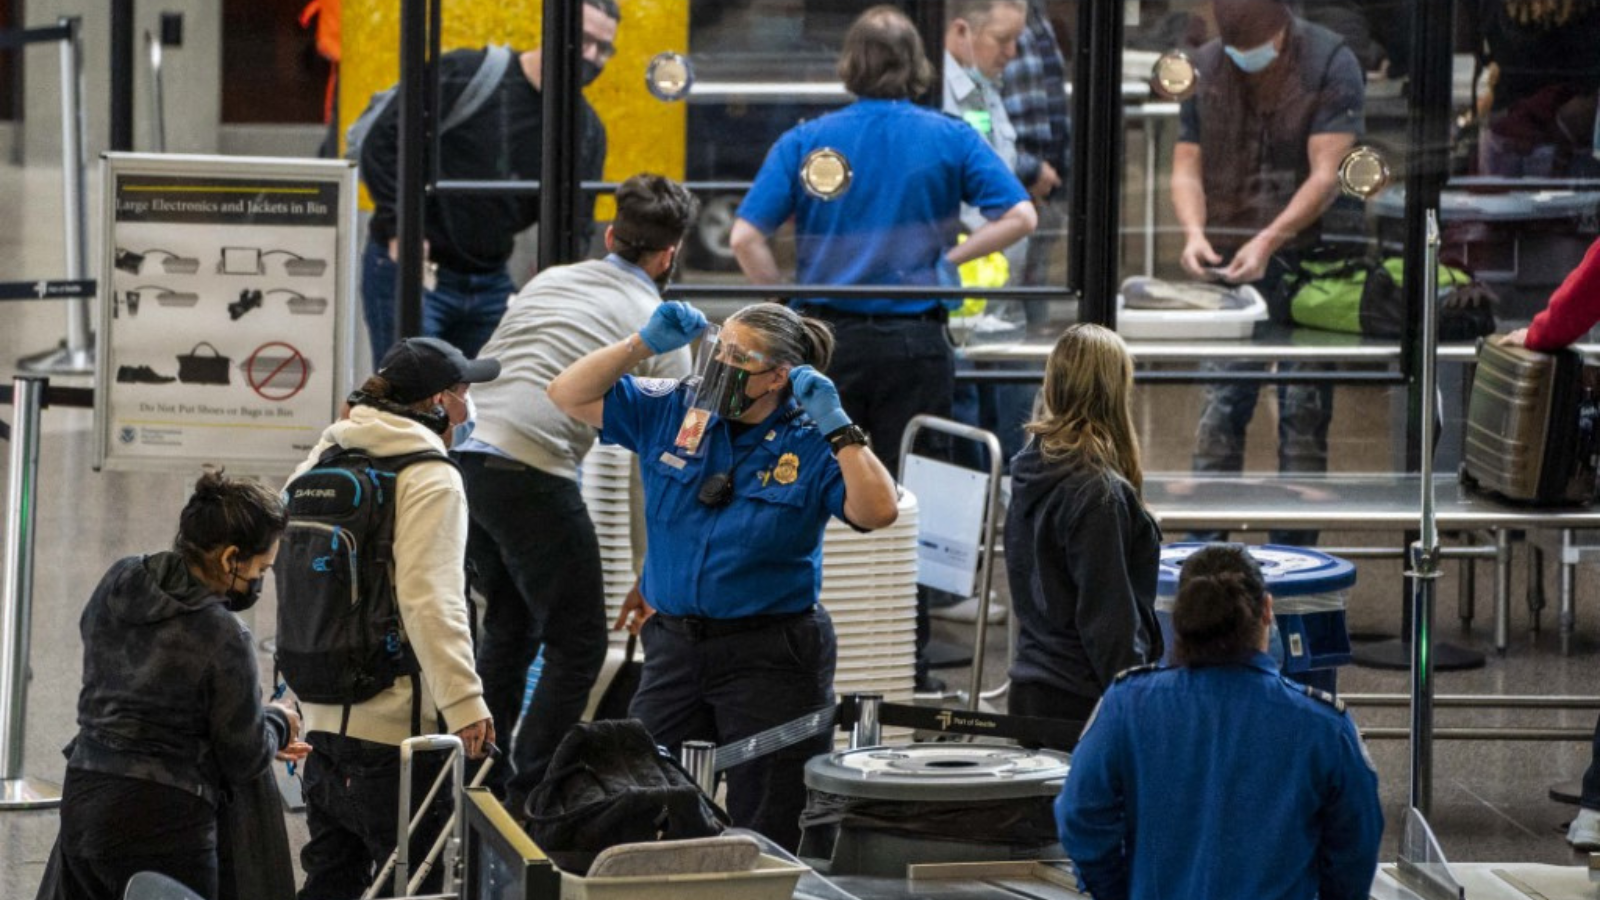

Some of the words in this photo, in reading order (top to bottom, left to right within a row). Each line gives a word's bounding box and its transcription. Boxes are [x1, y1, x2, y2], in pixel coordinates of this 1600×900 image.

[116, 198, 148, 214] Large
[152, 199, 218, 212] Electronics
[221, 200, 244, 213] and
[247, 200, 289, 214] Jackets
[290, 201, 304, 213] in
[307, 201, 328, 214] Bin
[139, 402, 155, 412] Do
[157, 403, 175, 413] Not
[179, 403, 195, 413] Put
[198, 404, 225, 415] Shoes
[240, 406, 262, 419] Bags
[294, 488, 336, 498] DAKINE
